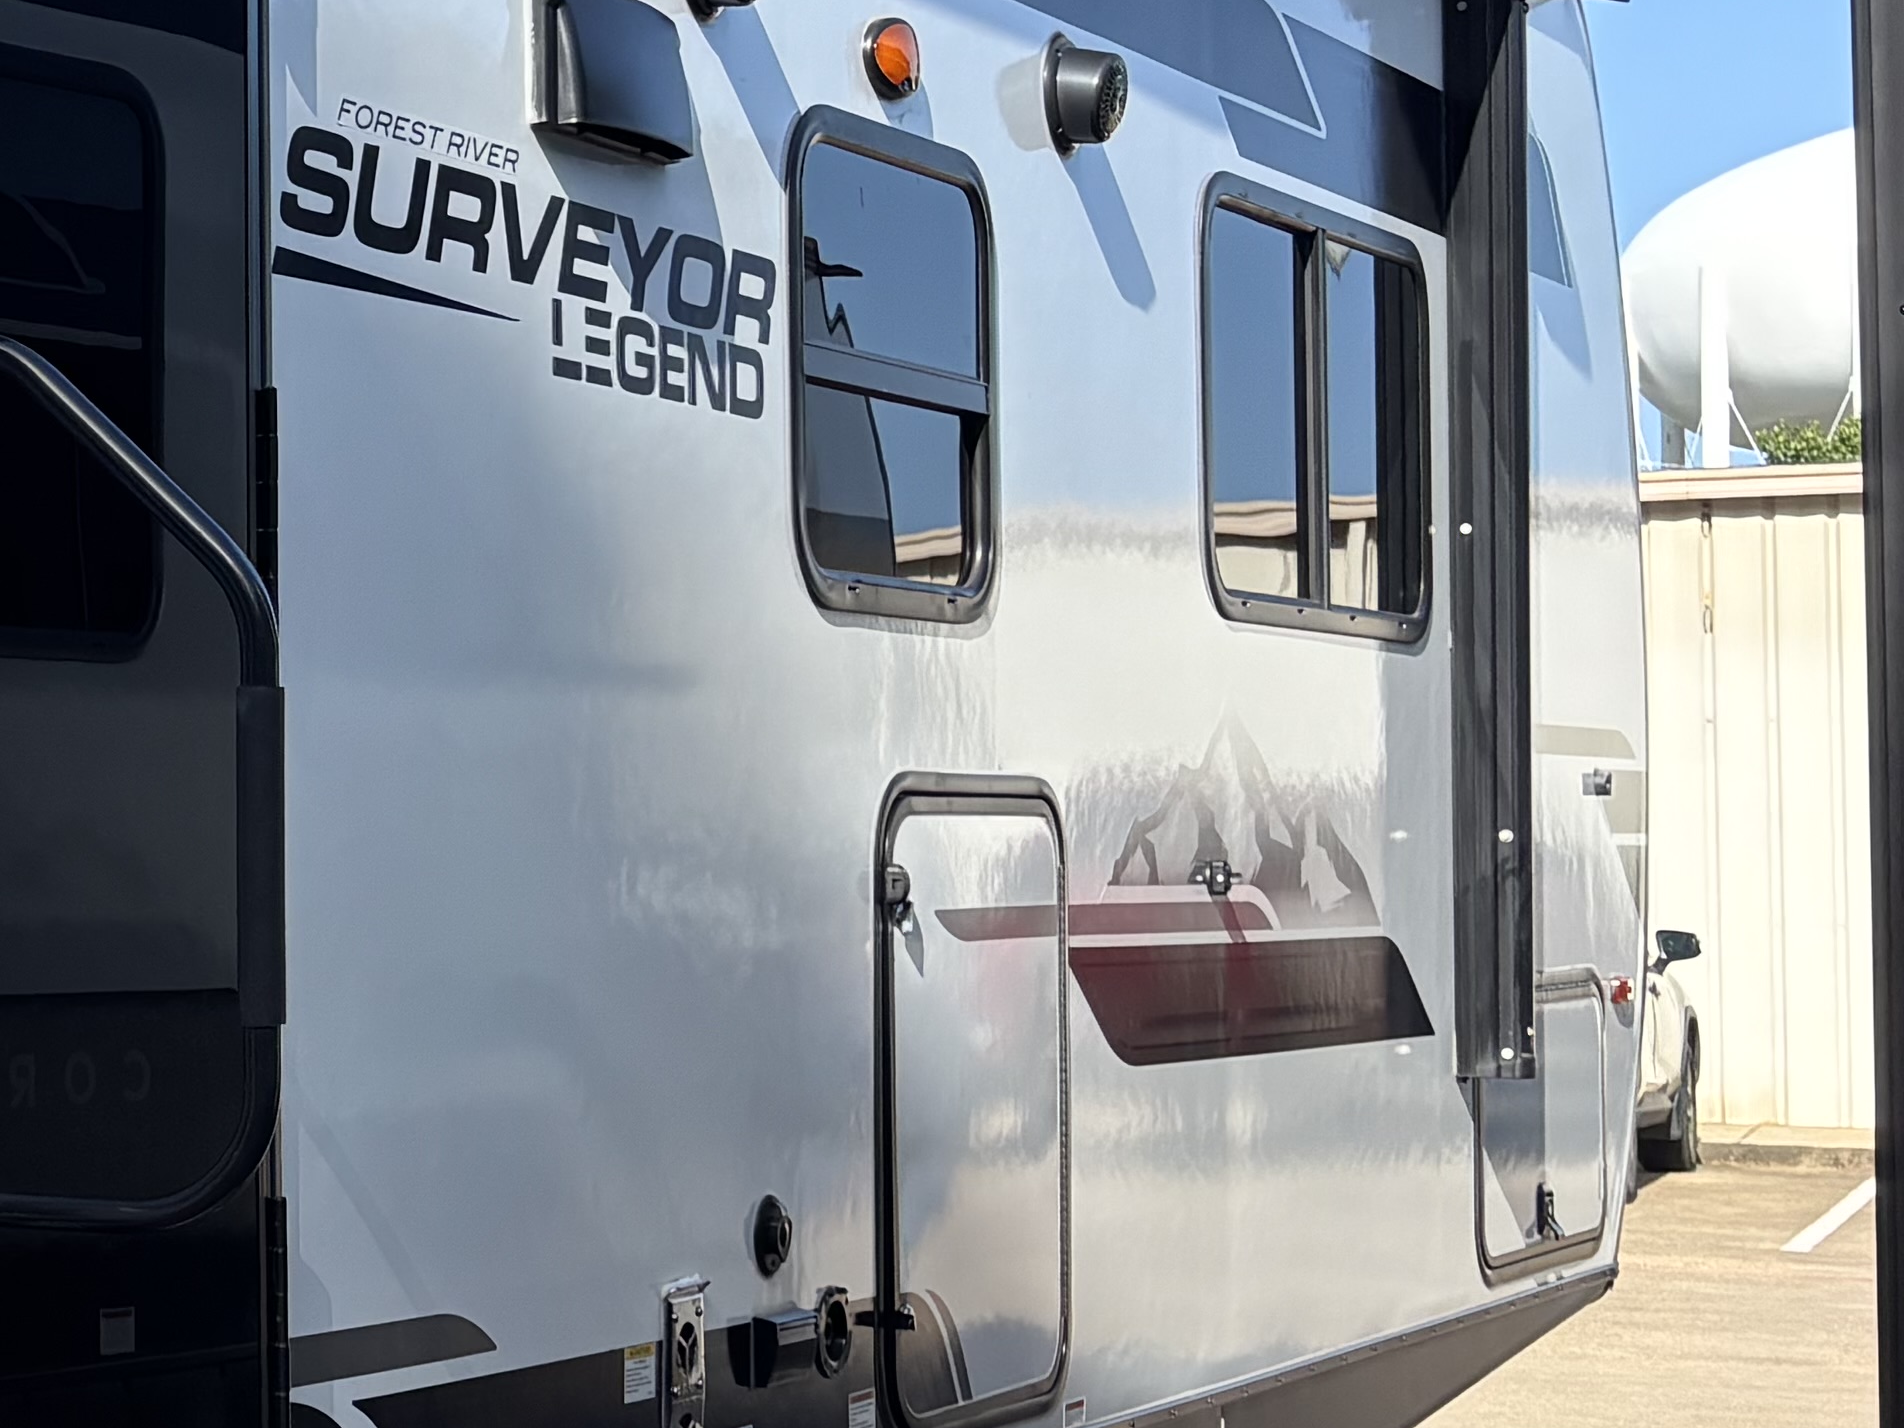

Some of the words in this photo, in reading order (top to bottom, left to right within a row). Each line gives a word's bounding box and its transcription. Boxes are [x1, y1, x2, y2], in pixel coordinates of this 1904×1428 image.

[337, 98, 444, 150] FOREST
[446, 130, 520, 174] RIVER
[279, 124, 777, 346] SURVEYOR
[551, 298, 764, 420] LEGEND
